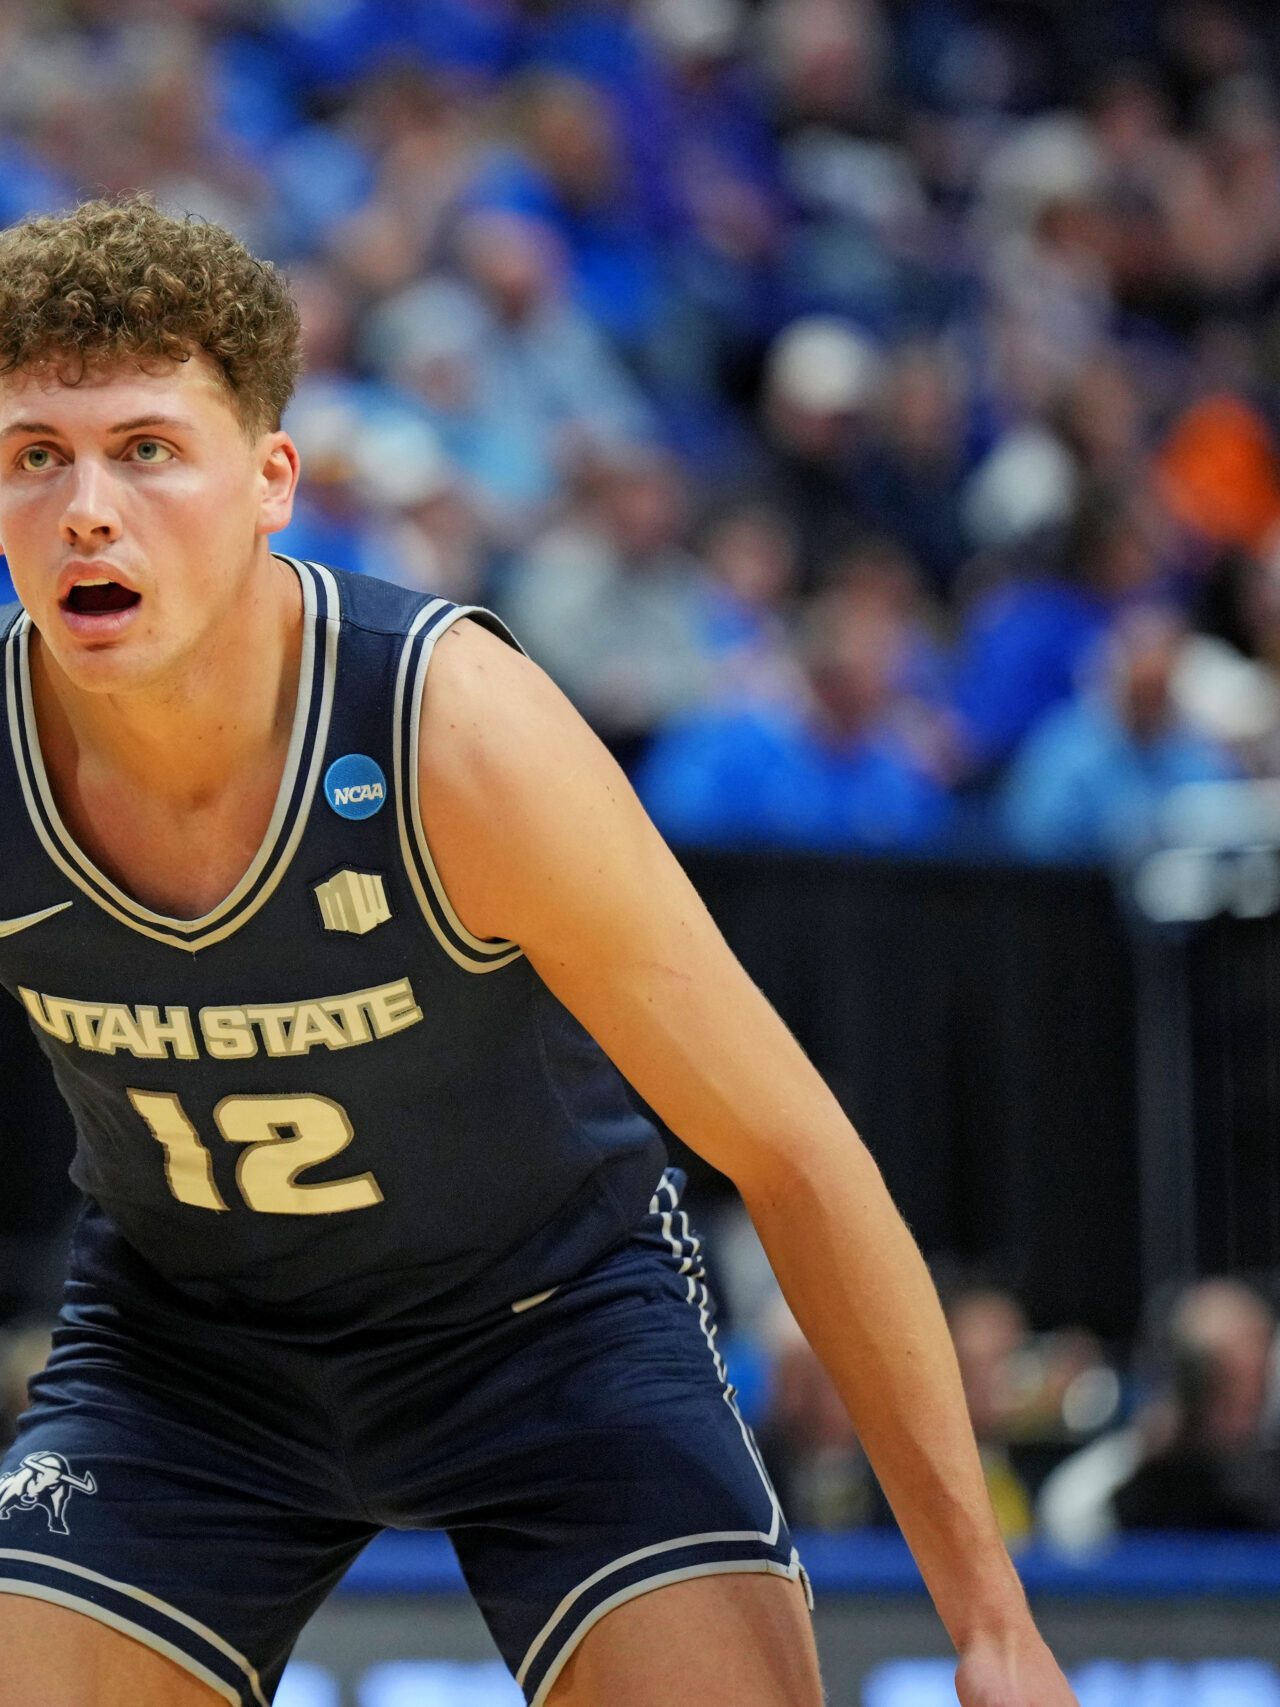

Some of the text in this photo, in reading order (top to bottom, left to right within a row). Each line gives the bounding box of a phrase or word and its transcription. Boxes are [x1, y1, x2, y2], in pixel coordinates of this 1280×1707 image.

[334, 783, 384, 806] NCAA
[18, 977, 423, 1060] UTAH STATE
[126, 1087, 385, 1216] 12
